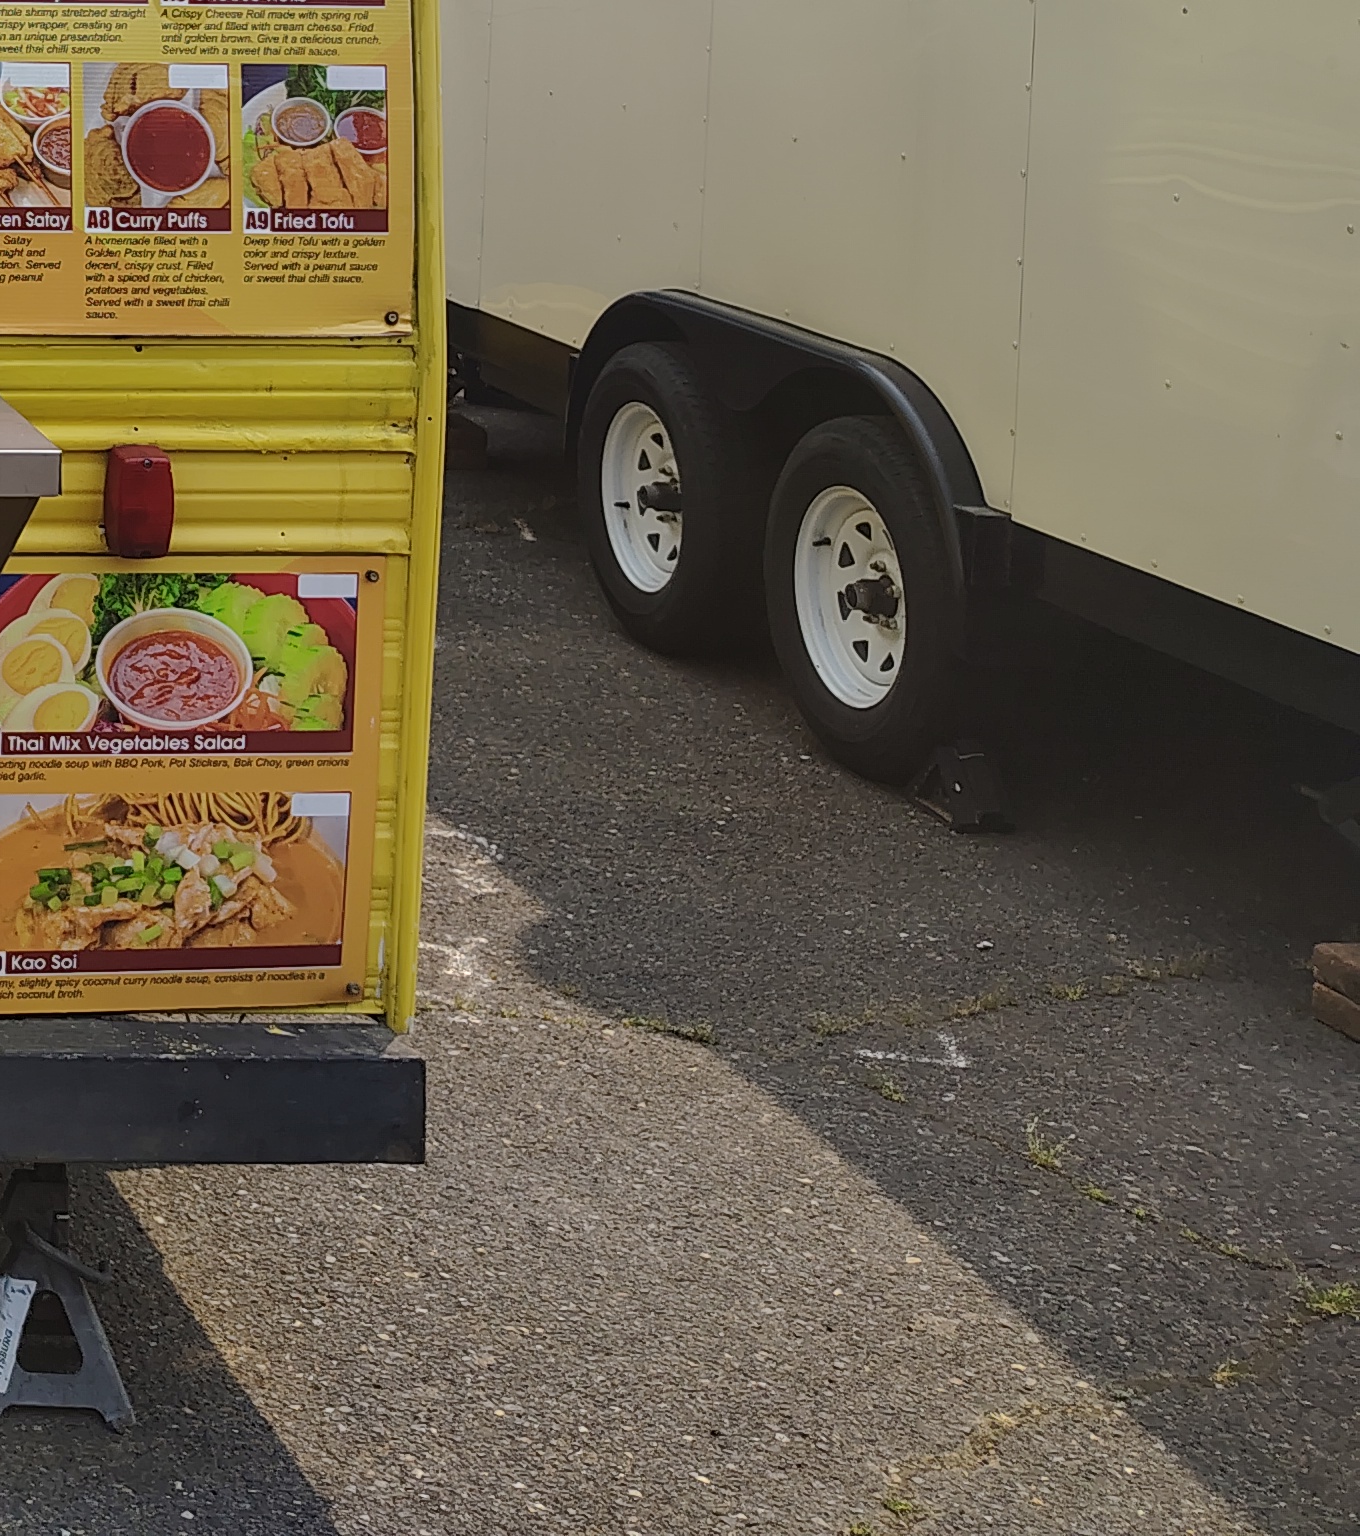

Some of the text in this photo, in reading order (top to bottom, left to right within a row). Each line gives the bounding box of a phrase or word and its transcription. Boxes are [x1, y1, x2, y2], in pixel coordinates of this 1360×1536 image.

[26, 211, 70, 230] Satay
[87, 210, 207, 231] A8 Curry Puffs
[246, 211, 354, 229] A9 Fried Tofu
[4, 236, 32, 246] Satay
[26, 248, 45, 256] and
[26, 260, 61, 269] Served
[8, 273, 44, 283] peanut
[8, 736, 43, 751] Thai
[49, 736, 80, 751] Mix
[87, 736, 189, 754] Vegetables
[194, 736, 246, 750] Salad
[12, 956, 46, 971] Kao
[52, 955, 77, 970] Soi
